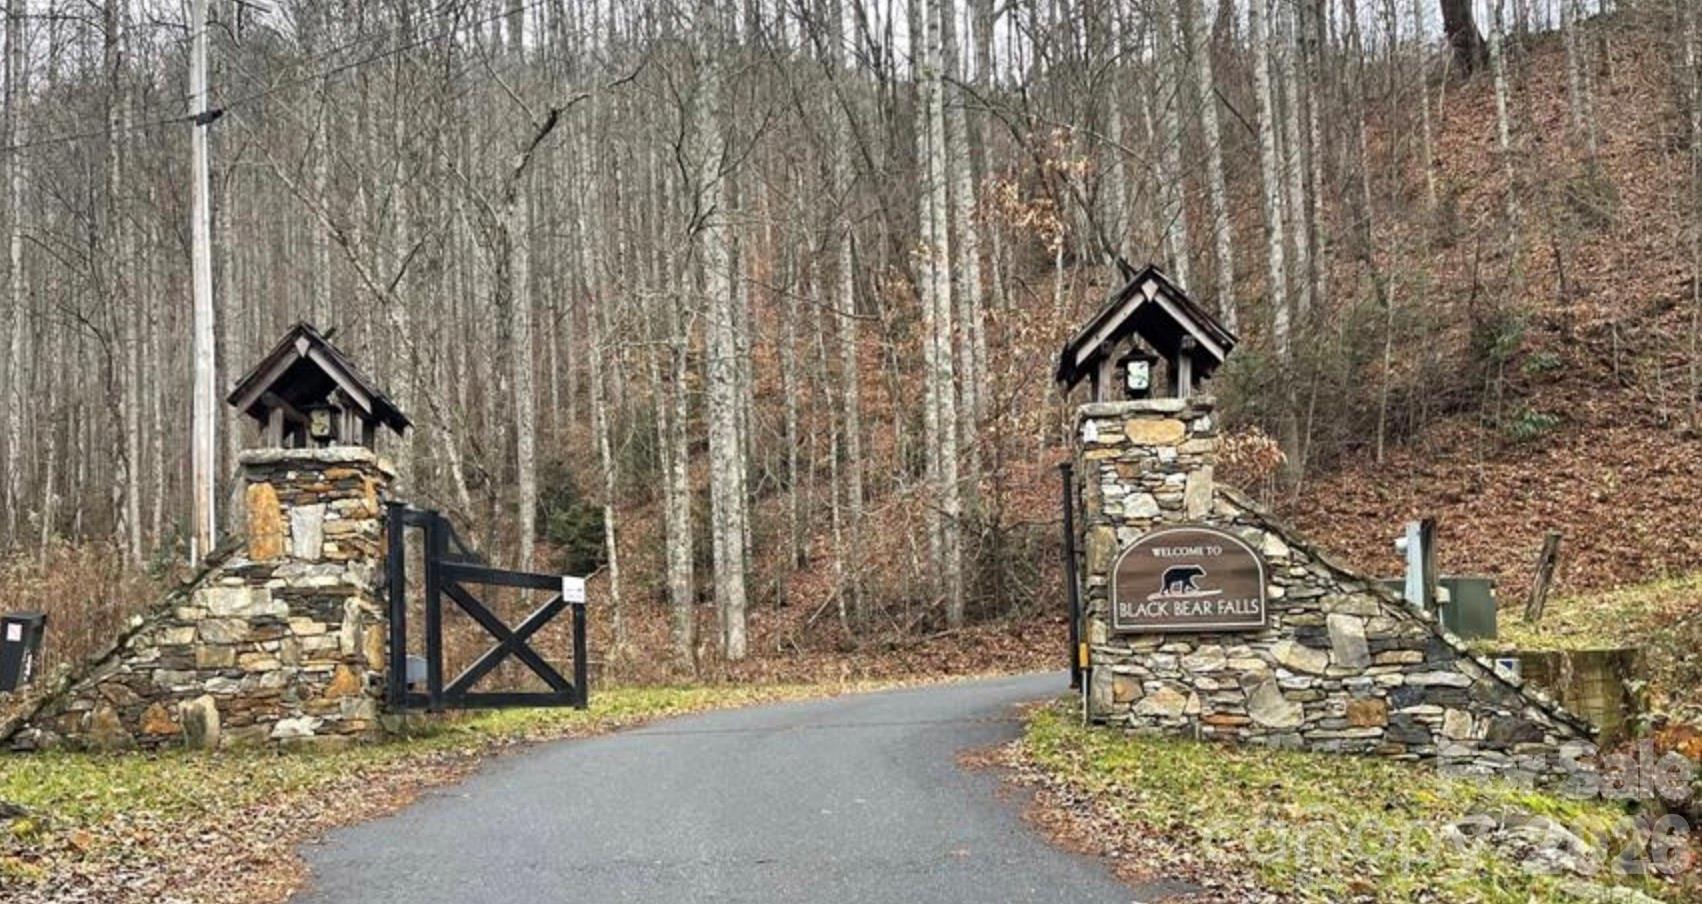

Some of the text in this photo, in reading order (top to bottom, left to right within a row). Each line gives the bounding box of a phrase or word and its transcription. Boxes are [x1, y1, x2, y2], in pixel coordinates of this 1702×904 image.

[1152, 546, 1222, 557] WELCOME TO
[1119, 599, 1259, 618] BLACK BEAR FALLS
